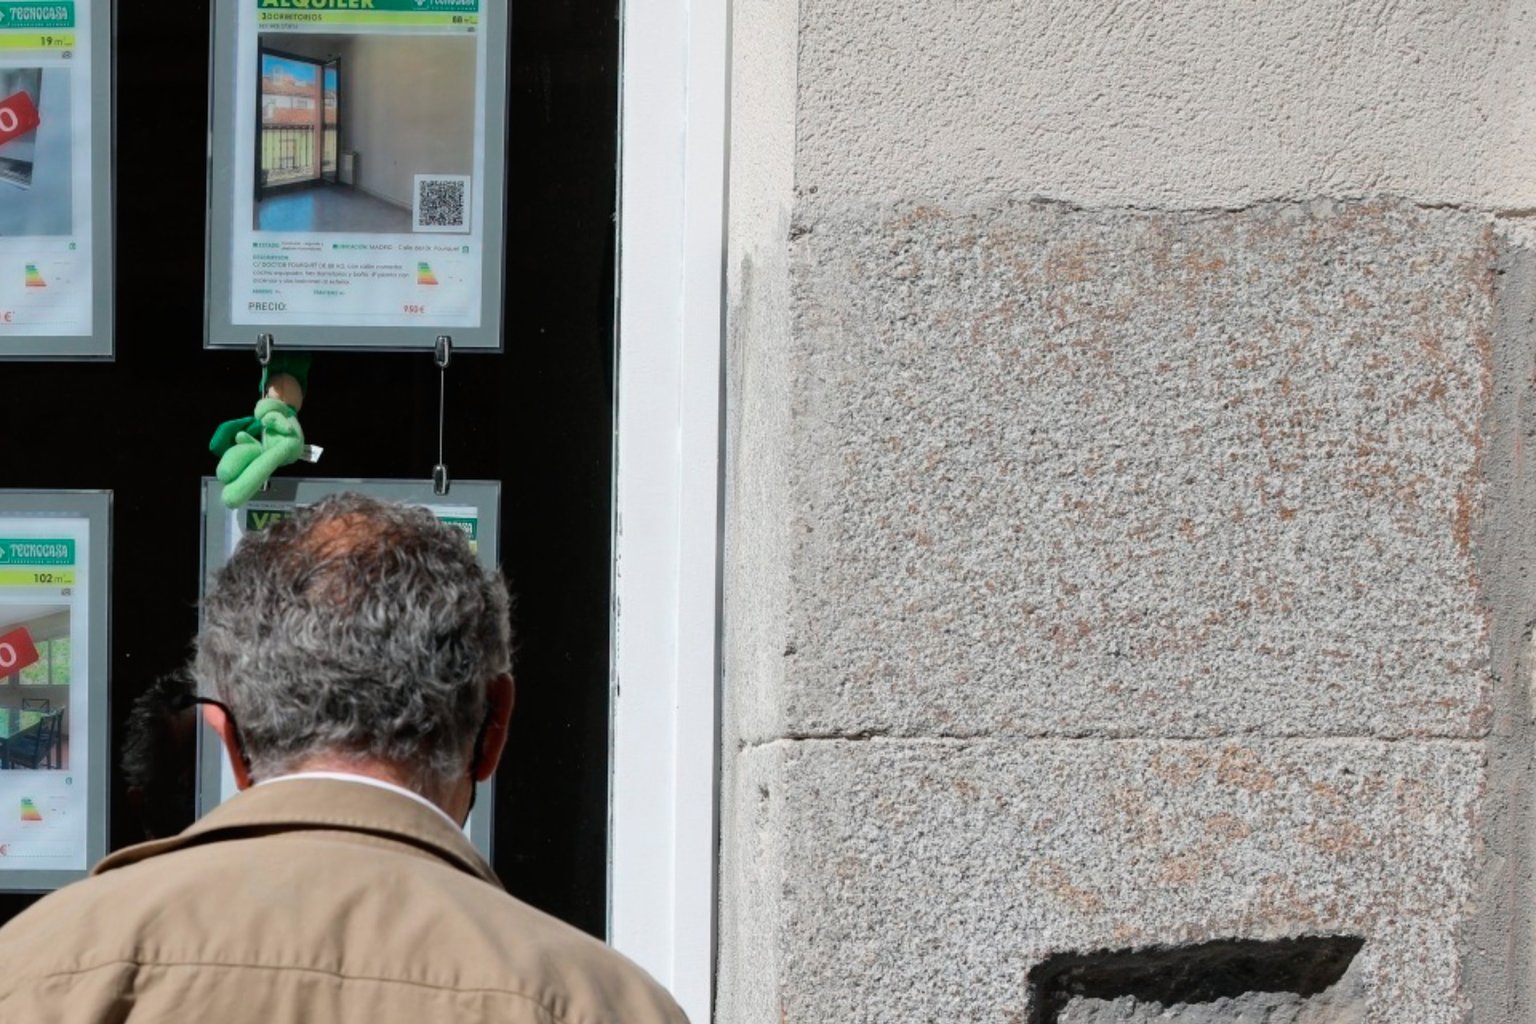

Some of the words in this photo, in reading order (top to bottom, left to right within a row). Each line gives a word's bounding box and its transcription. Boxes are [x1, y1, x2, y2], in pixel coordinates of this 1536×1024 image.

[10, 6, 68, 21] TECNOCASA
[40, 36, 53, 46] 19
[248, 302, 287, 312] PRECIO:
[3, 312, 13, 323] €
[10, 543, 69, 559] TECNOCASA
[33, 573, 53, 583] 102
[0, 844, 9, 856] €
